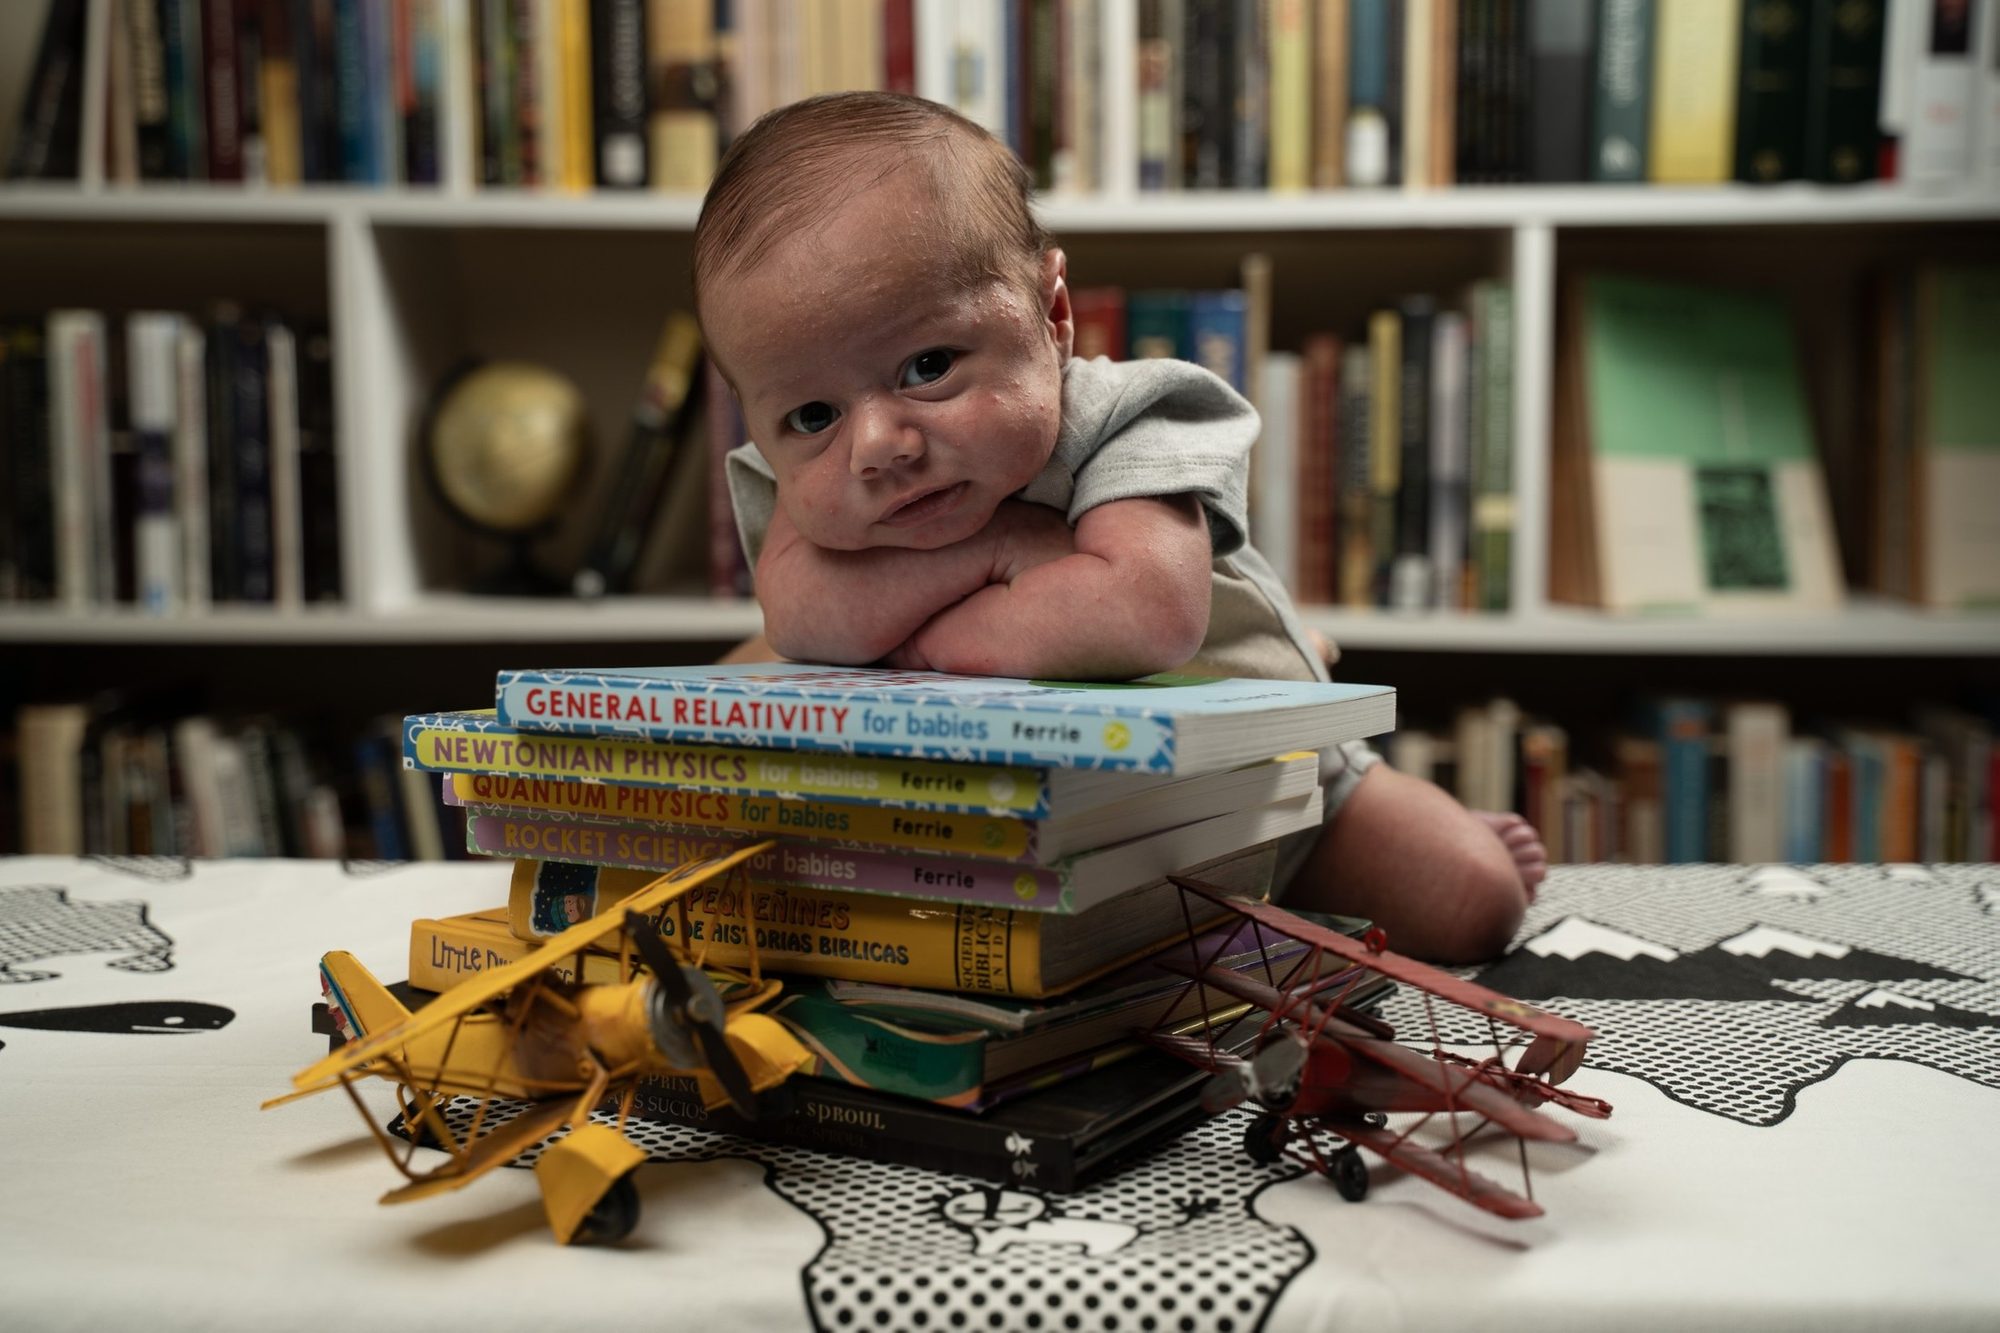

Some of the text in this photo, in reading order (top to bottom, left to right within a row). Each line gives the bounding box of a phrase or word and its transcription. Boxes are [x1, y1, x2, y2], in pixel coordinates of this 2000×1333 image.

[526, 688, 1080, 744] GENERAL RELATIVITY for babies Ferrie
[433, 736, 966, 792] NEWTONIAN PHYSICS for babies Ferrie
[473, 774, 954, 840] QUANTUM PHYSICS for babies Ferrie
[504, 823, 607, 857] ROCKET
[783, 850, 856, 879] babies
[914, 867, 975, 889] Ferrie
[819, 935, 909, 965] BIBLICAS
[961, 905, 975, 989] SOCIEDADE
[976, 906, 993, 989] BIBLICA
[993, 916, 1006, 991] UNIDA
[647, 1095, 709, 1121] SUCIOS
[648, 1071, 700, 1095] PRINC
